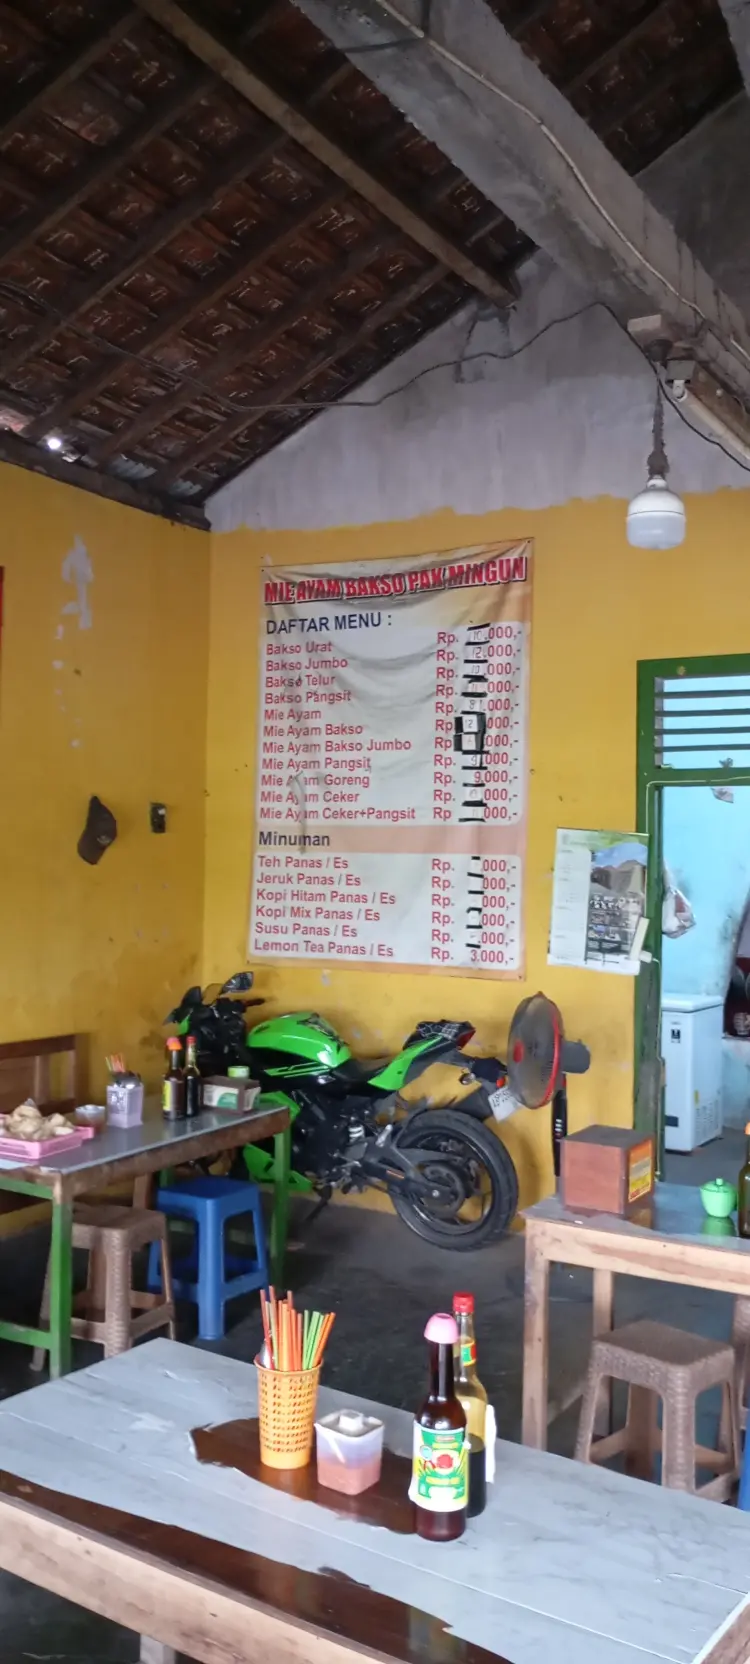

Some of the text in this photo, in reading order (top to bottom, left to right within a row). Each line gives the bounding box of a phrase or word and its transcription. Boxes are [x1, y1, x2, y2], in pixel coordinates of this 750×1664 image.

[264, 556, 526, 604] MIE AYAM BAKSO PAK MINGUN
[266, 616, 330, 634] DAFTAR
[334, 611, 382, 630] MENU
[266, 643, 302, 655] Bakso
[305, 640, 333, 654] Urat
[437, 631, 459, 647] Rp.
[266, 659, 302, 672] Bakso
[305, 656, 348, 670] Jumbo
[436, 649, 459, 663] Rp.
[265, 676, 303, 688] Bakso
[305, 674, 336, 686] Telur
[436, 667, 458, 681] Rp.
[264, 692, 302, 704] Bakso
[306, 690, 352, 705] Pangsit
[435, 684, 458, 699] Rp.
[264, 709, 284, 720] Mie
[287, 708, 322, 722] Ayam
[435, 701, 457, 716] Rp.
[263, 725, 284, 737] Mie
[286, 725, 322, 738] Ayam
[325, 723, 363, 736] Bakso
[262, 741, 284, 753] Mie
[287, 741, 321, 755] Ayam
[325, 739, 363, 752] Bakso
[366, 738, 412, 752] Jumbo
[261, 758, 284, 770] Mie
[286, 758, 320, 771] Ayam
[324, 757, 371, 771] Pangsit
[433, 754, 456, 769] Rp.
[261, 774, 283, 786] Mie
[324, 773, 370, 788] Goreng
[433, 771, 456, 786] Rp.
[474, 770, 518, 784] 9.000,-
[260, 791, 283, 802] Mie
[323, 790, 360, 802] Ceker
[433, 789, 455, 804] Rp.
[259, 807, 282, 819] Mie
[322, 806, 416, 822] Ceker+Pangsit
[258, 831, 330, 846] Minuman
[258, 855, 280, 867] Teh
[285, 856, 323, 868] Panas
[333, 857, 349, 869] Es
[431, 858, 455, 874] Rp.
[256, 872, 293, 884] Jeruk
[297, 873, 335, 885] Panas
[345, 874, 361, 886] Es
[431, 876, 455, 891] Rp.
[256, 888, 287, 903] Kopi
[291, 889, 326, 902] Hitam
[330, 890, 368, 904] Panas
[379, 892, 396, 905] Es
[431, 893, 455, 909] Rp.
[255, 905, 286, 920] Kopi
[290, 906, 311, 918] Mix
[315, 907, 353, 920] Panas
[364, 908, 380, 921] Es
[431, 911, 455, 926] Rp.
[255, 921, 288, 934] Susu
[292, 923, 330, 936] Panas
[342, 924, 358, 937] Es
[431, 929, 454, 944] Rp.
[254, 938, 299, 952] Lemon
[303, 940, 324, 953] Tea
[328, 941, 366, 955] Panas
[377, 944, 394, 957] Es
[431, 947, 454, 962] Rp.
[470, 949, 514, 965] 3.000,-
